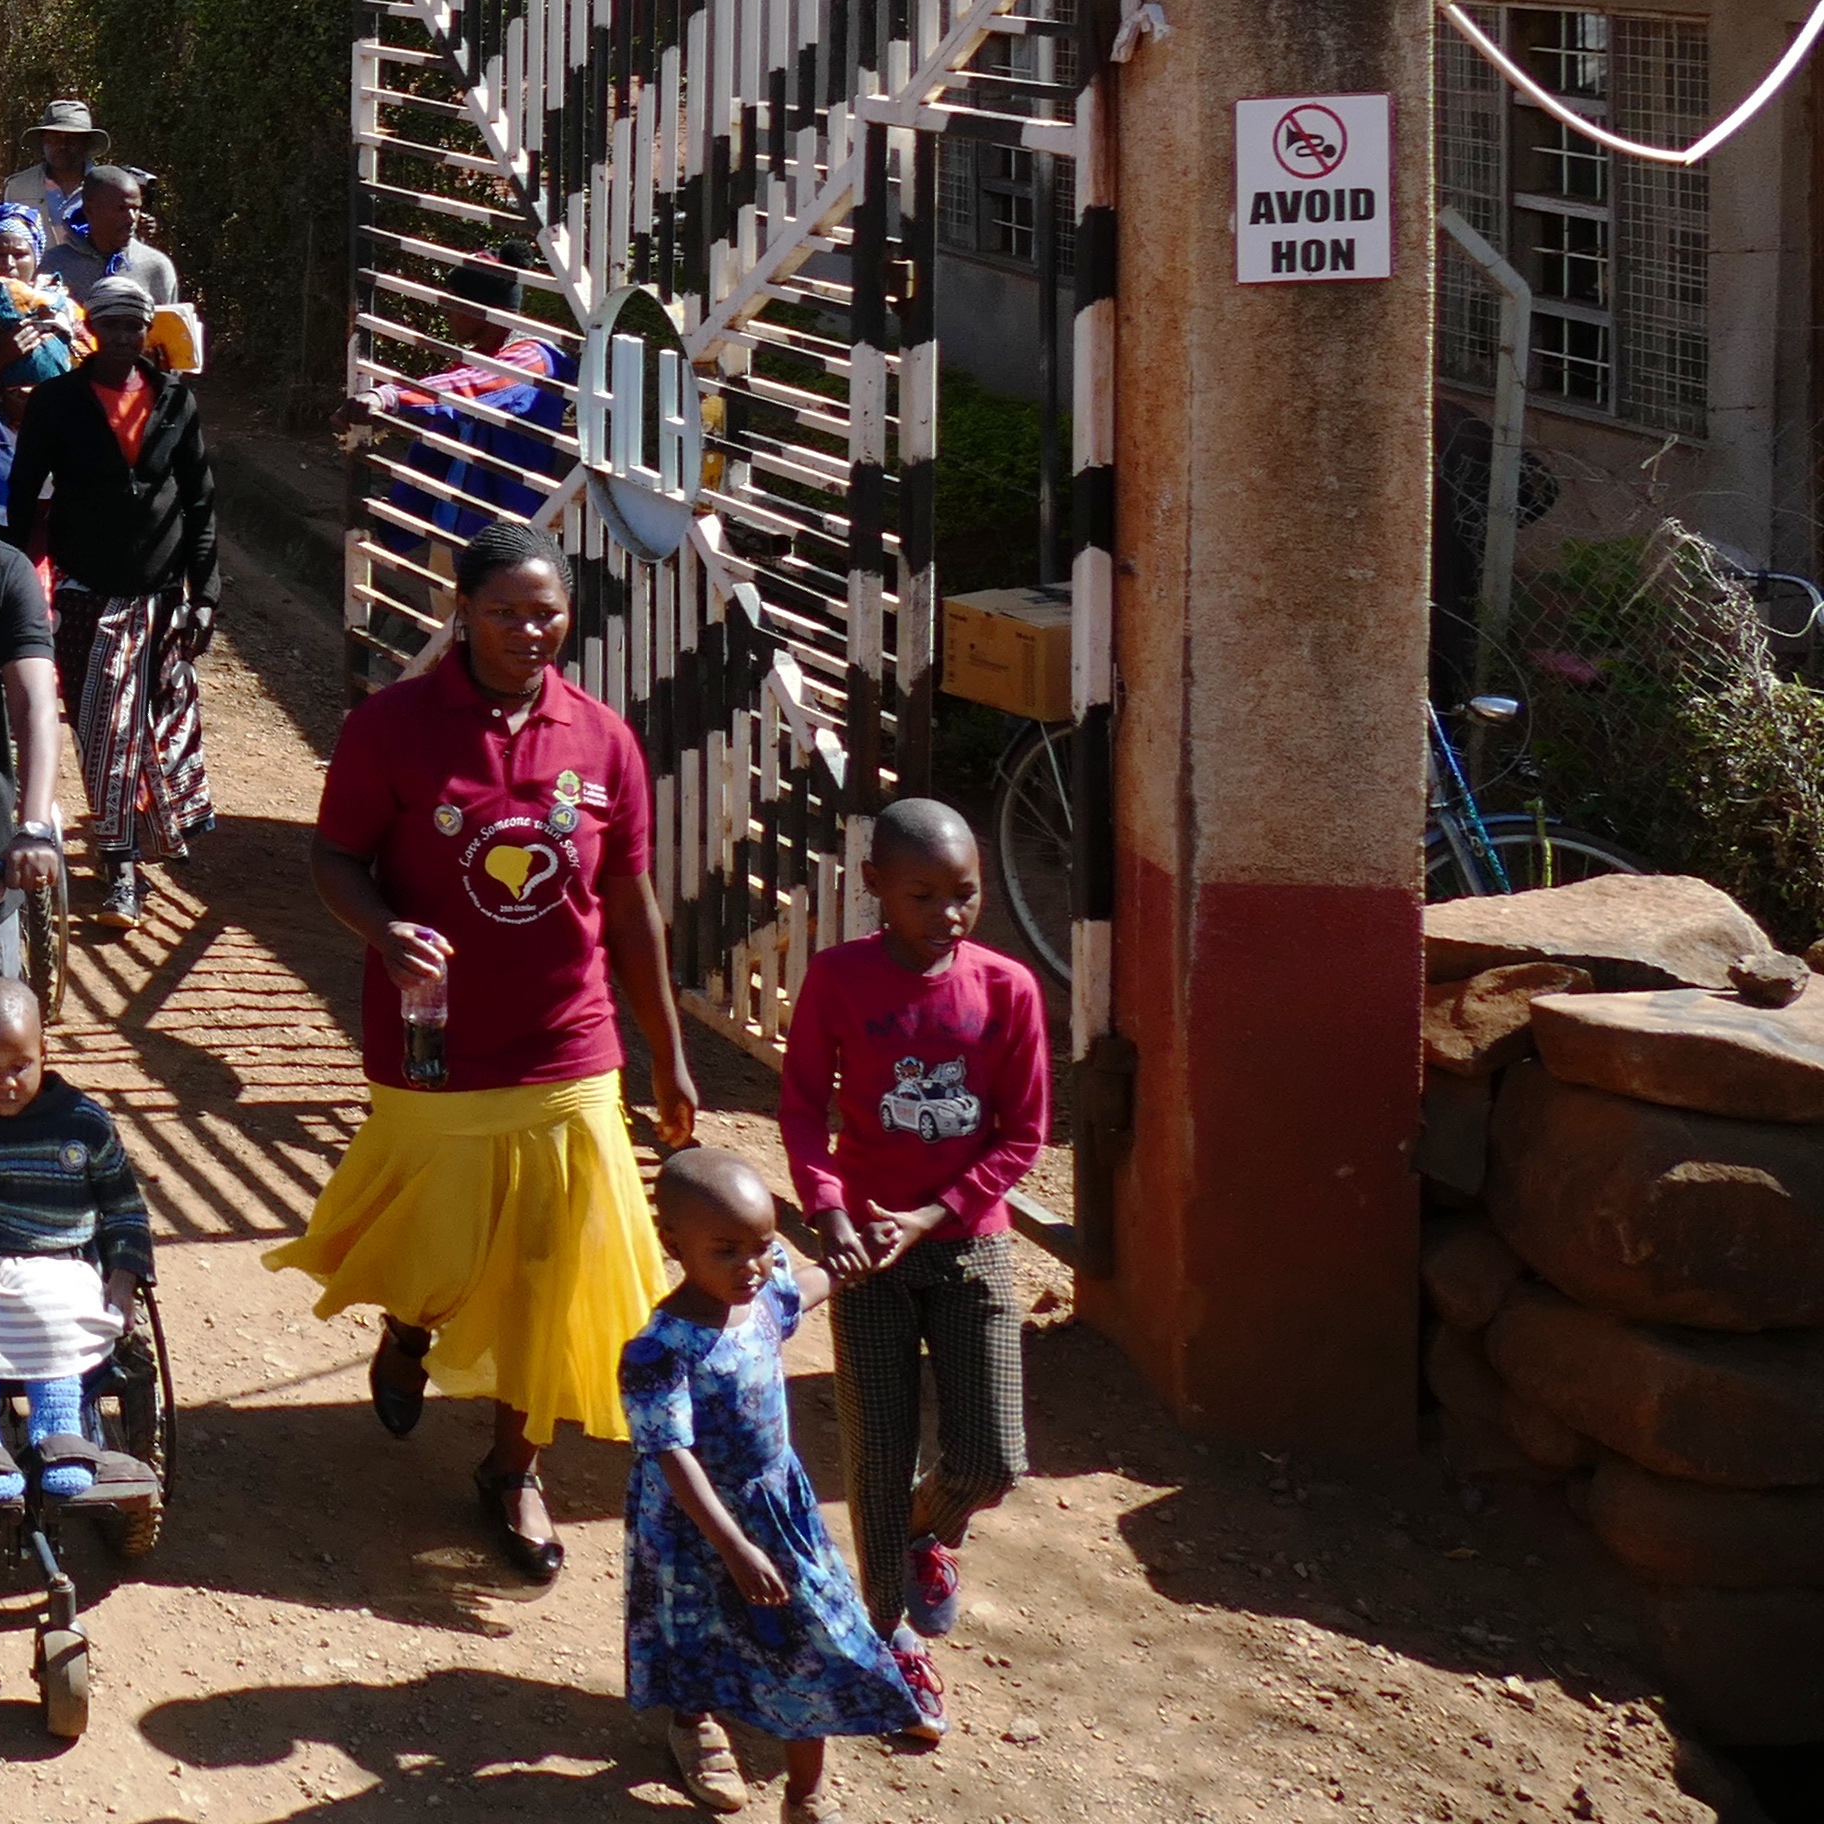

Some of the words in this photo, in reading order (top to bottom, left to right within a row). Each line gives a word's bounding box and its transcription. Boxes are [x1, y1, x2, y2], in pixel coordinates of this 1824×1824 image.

[1249, 188, 1375, 225] AVOID
[1271, 238, 1356, 274] HON
[458, 837, 482, 868] Love
[479, 816, 531, 841] Someone
